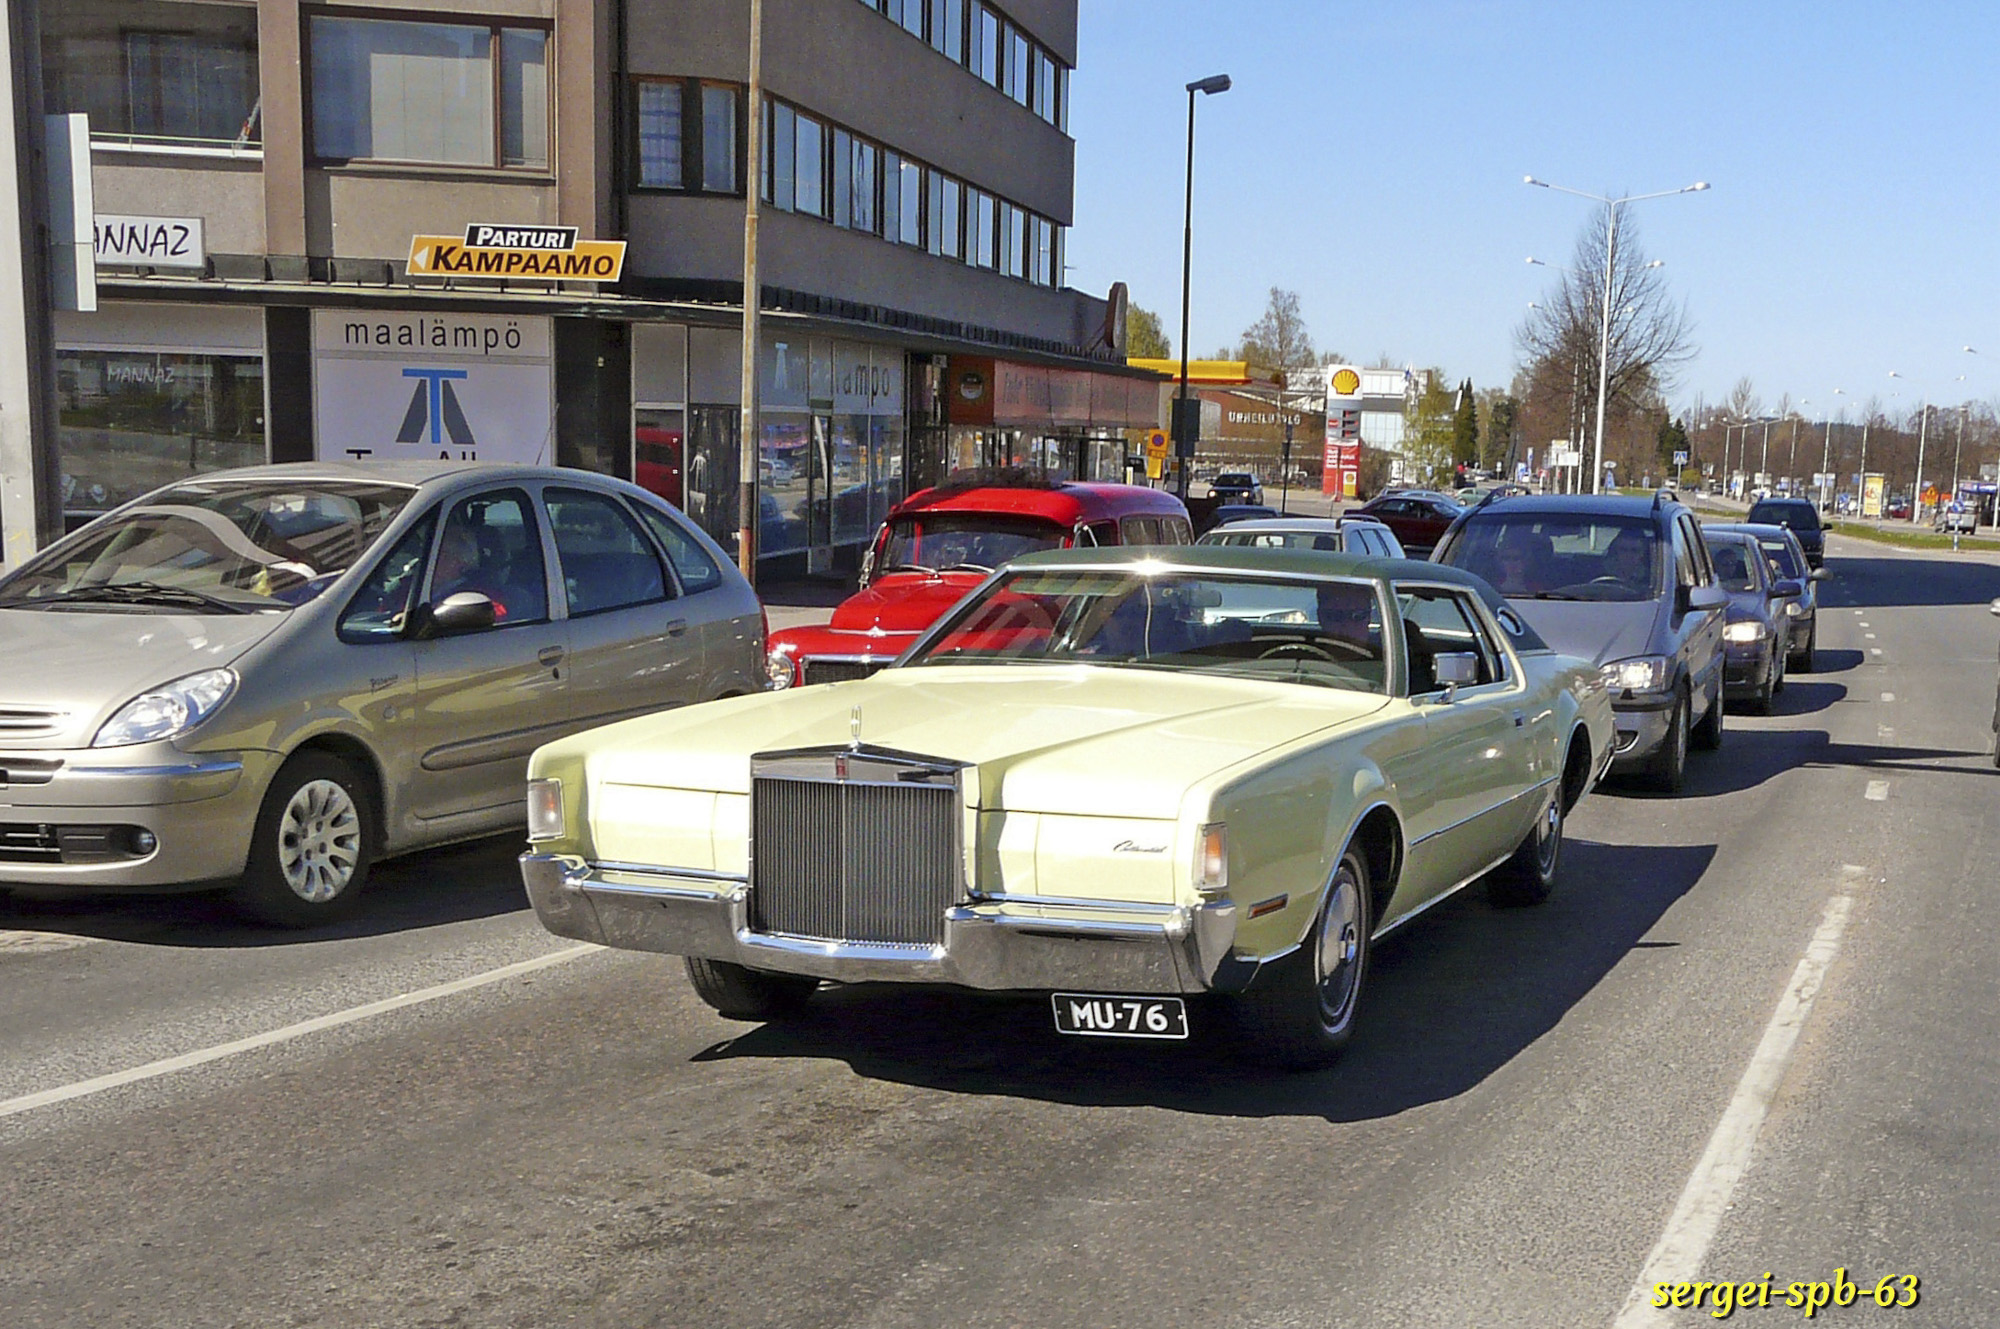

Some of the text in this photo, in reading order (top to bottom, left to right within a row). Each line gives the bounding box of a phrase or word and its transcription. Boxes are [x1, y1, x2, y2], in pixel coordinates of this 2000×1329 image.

[475, 226, 567, 249] PARTURI
[431, 245, 615, 277] KAMPAAMO
[345, 318, 521, 355] maalämpö
[107, 364, 175, 384] MANNAZ
[1228, 410, 1301, 425] URHEILULO
